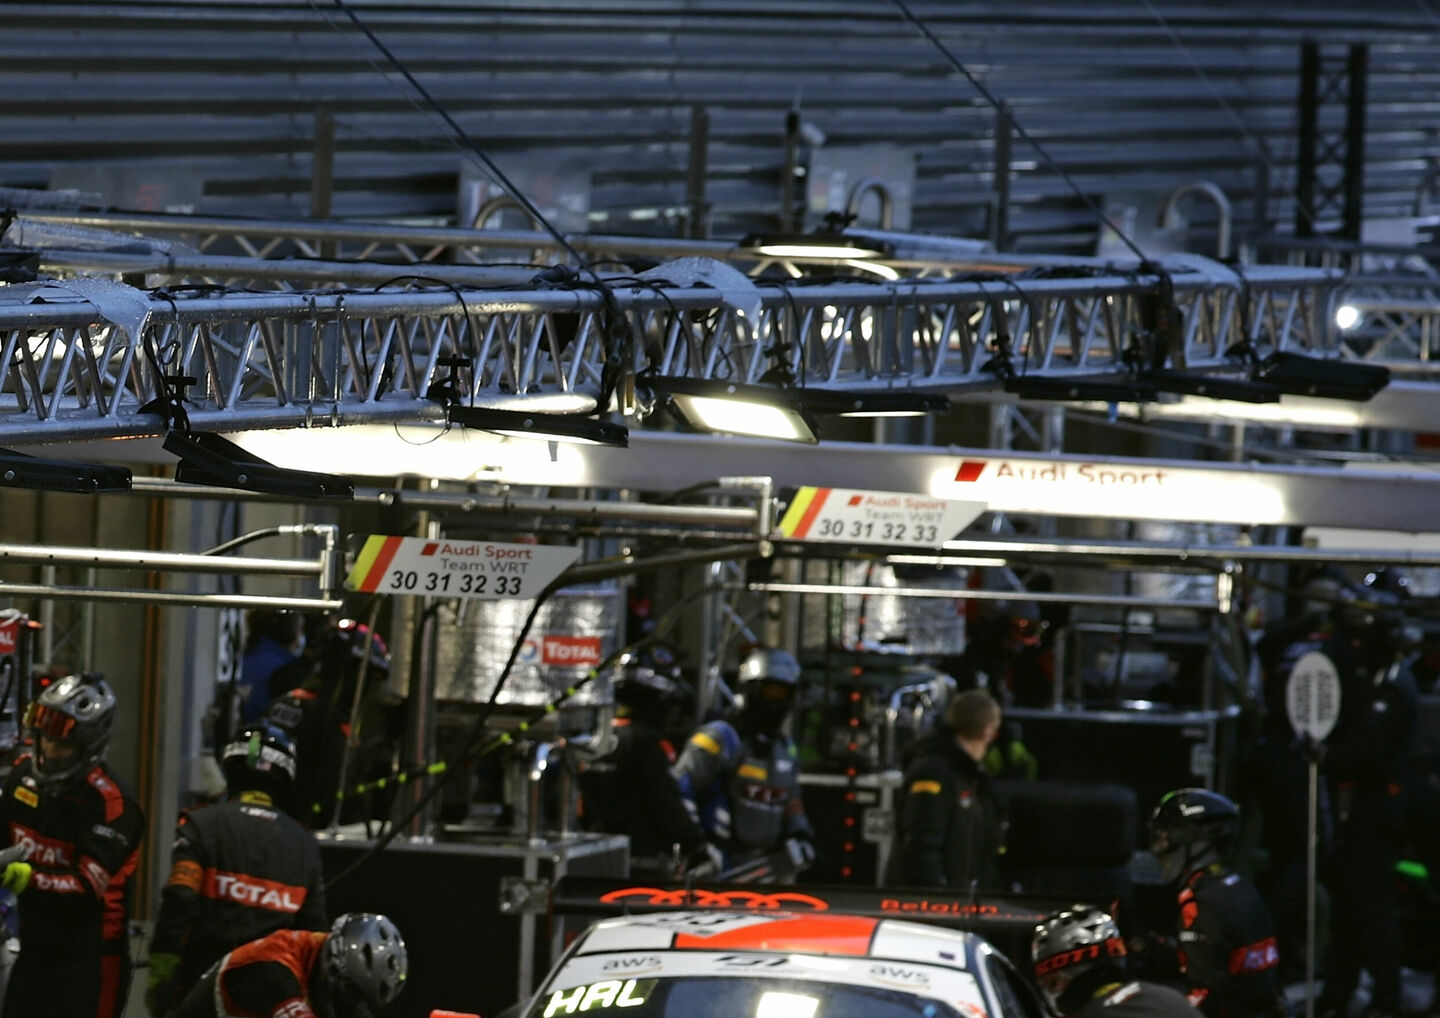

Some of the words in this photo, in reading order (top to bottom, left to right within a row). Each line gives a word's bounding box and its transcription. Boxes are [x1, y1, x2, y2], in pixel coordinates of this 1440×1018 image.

[997, 460, 1065, 482] Audi
[1077, 463, 1168, 486] Sport
[820, 518, 844, 536] 30
[851, 521, 874, 537] 31
[882, 523, 906, 540] 32
[915, 525, 938, 542] 33
[440, 543, 479, 558] Audi
[485, 545, 533, 561] Sport
[441, 558, 485, 572] Team
[489, 560, 530, 575] WRT
[390, 570, 418, 591] 30
[425, 572, 451, 592] 31
[460, 574, 487, 594] 32
[494, 576, 522, 596] 33
[544, 640, 600, 660] TOTAL
[13, 827, 71, 867] TOTAL
[214, 874, 301, 911] TOTAL
[602, 953, 662, 971] aws
[869, 964, 931, 985] aws
